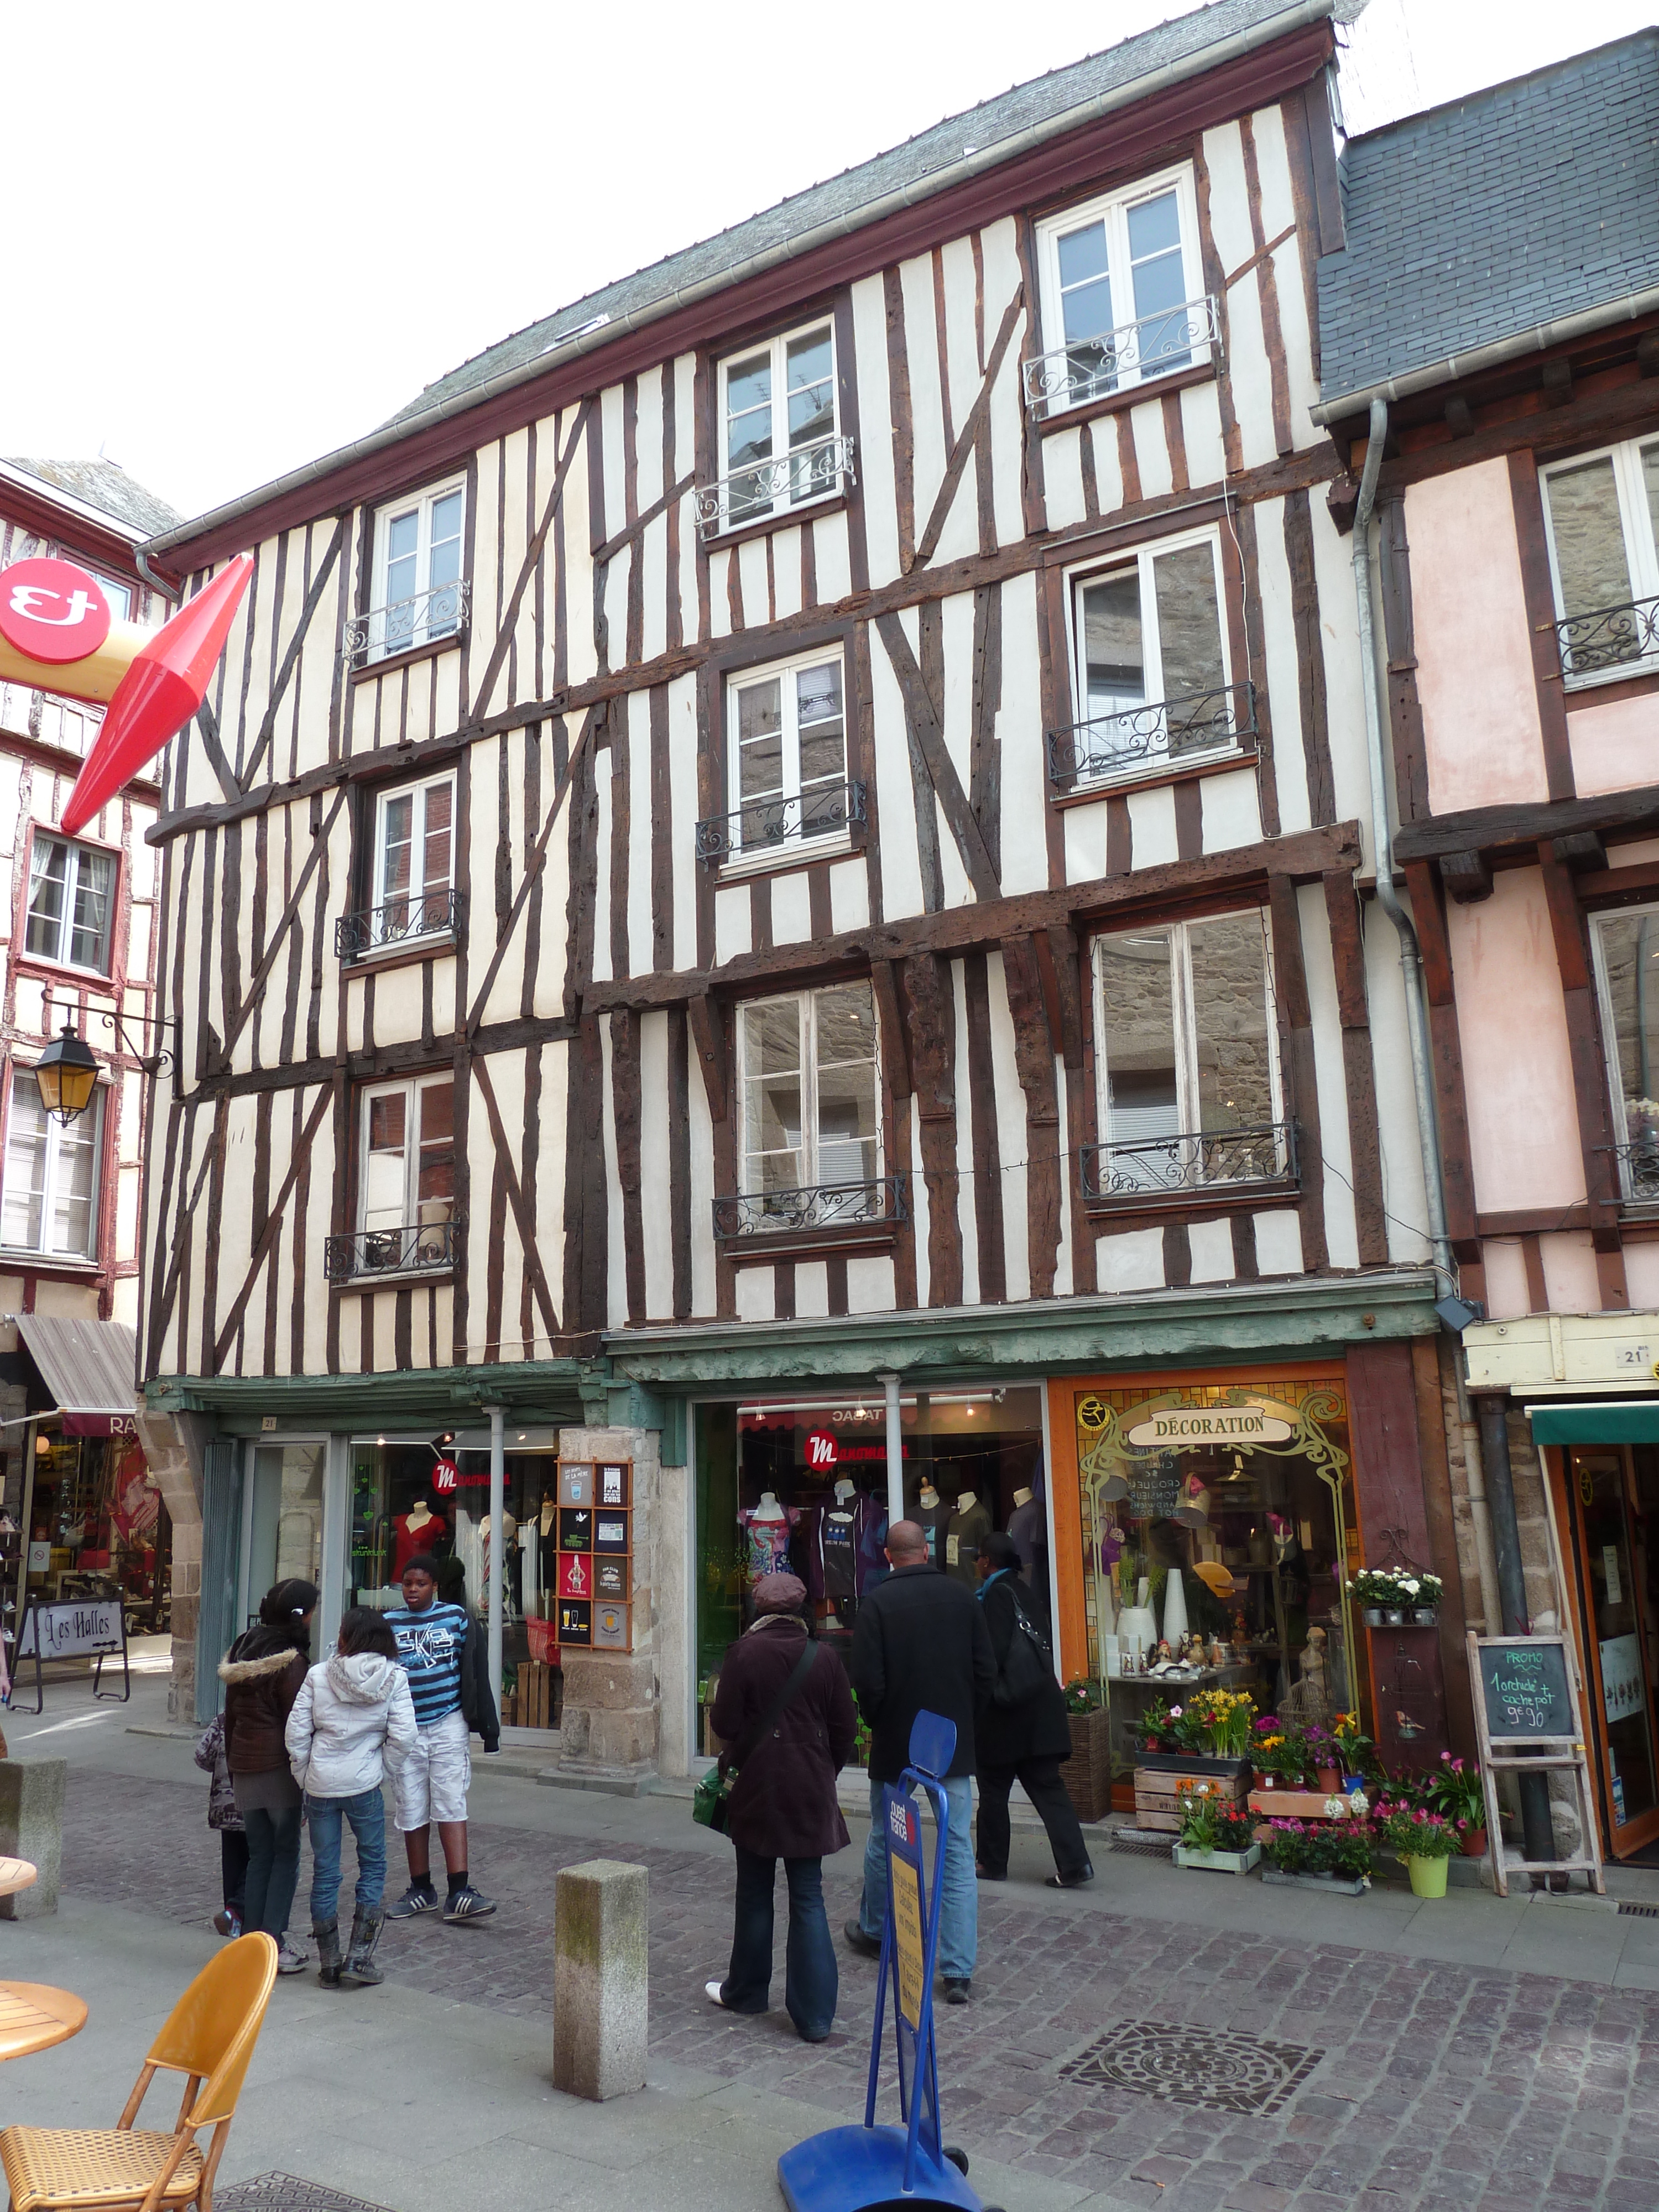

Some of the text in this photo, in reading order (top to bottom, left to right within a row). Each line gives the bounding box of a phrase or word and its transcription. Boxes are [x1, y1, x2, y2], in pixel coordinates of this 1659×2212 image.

[1625, 1351, 1641, 1362] 21
[1155, 1416, 1264, 1437] DÉCORATION
[45, 1610, 109, 1650] Les Halles
[1506, 1651, 1543, 1663] PROMO
[1490, 1672, 1500, 1692] 1
[1502, 1693, 1556, 1710] cache pot
[891, 1801, 906, 1825] ouest
[890, 1811, 907, 1841] france
